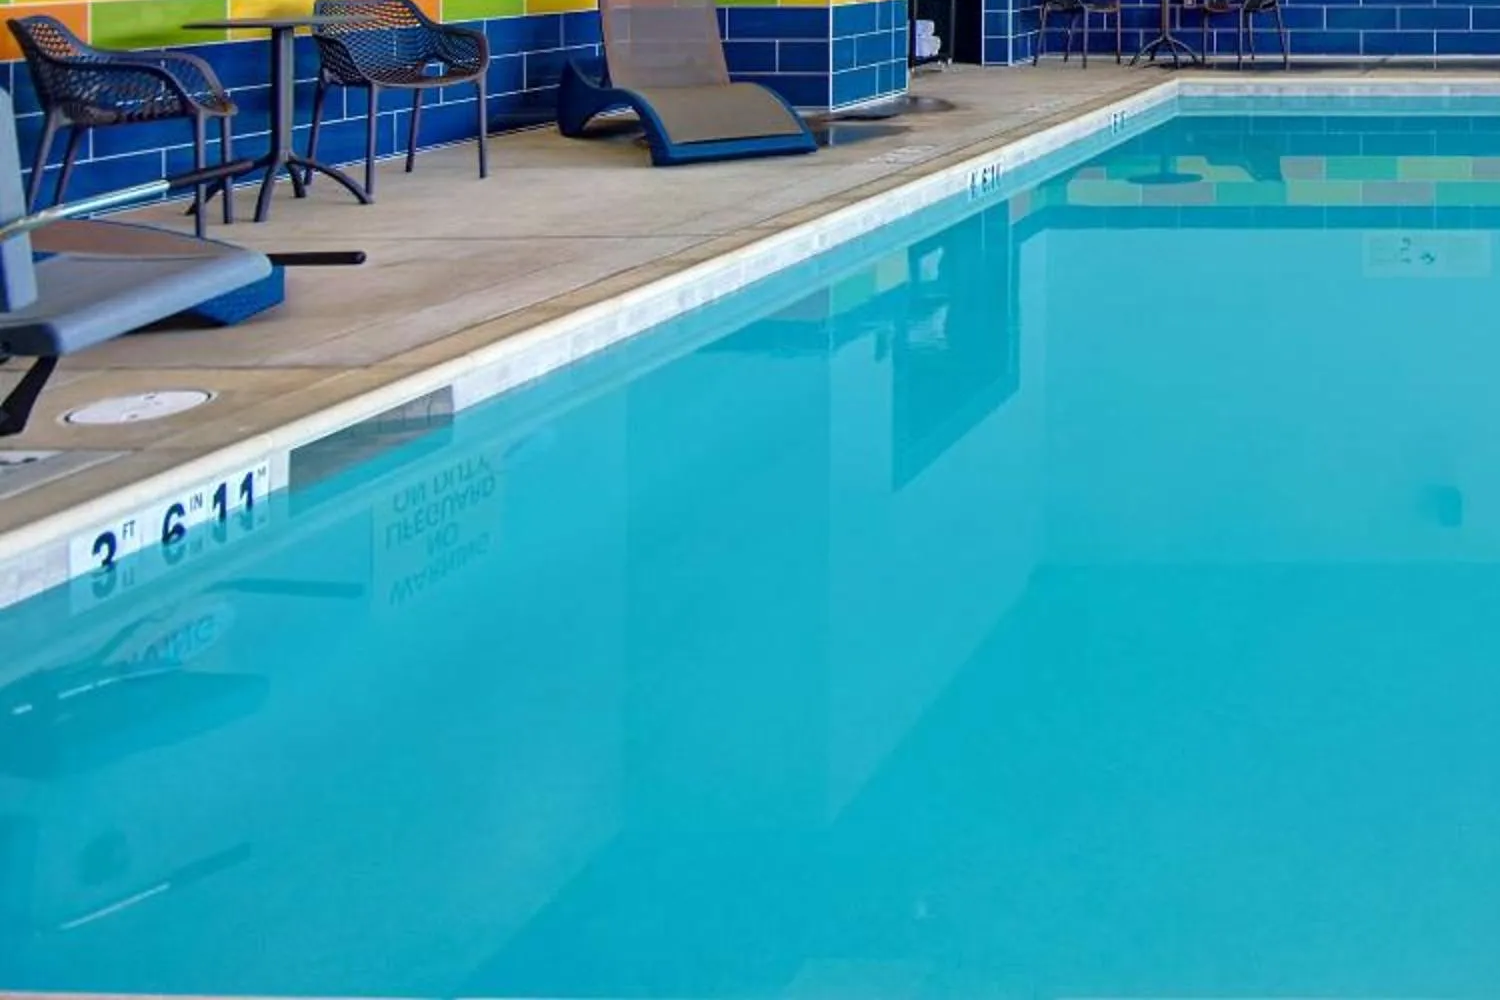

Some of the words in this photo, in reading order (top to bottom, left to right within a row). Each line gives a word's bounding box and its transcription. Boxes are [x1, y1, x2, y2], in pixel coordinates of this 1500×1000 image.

[92, 531, 117, 572] 3
[122, 519, 136, 540] FT
[162, 502, 187, 544] 6
[190, 492, 203, 511] IN
